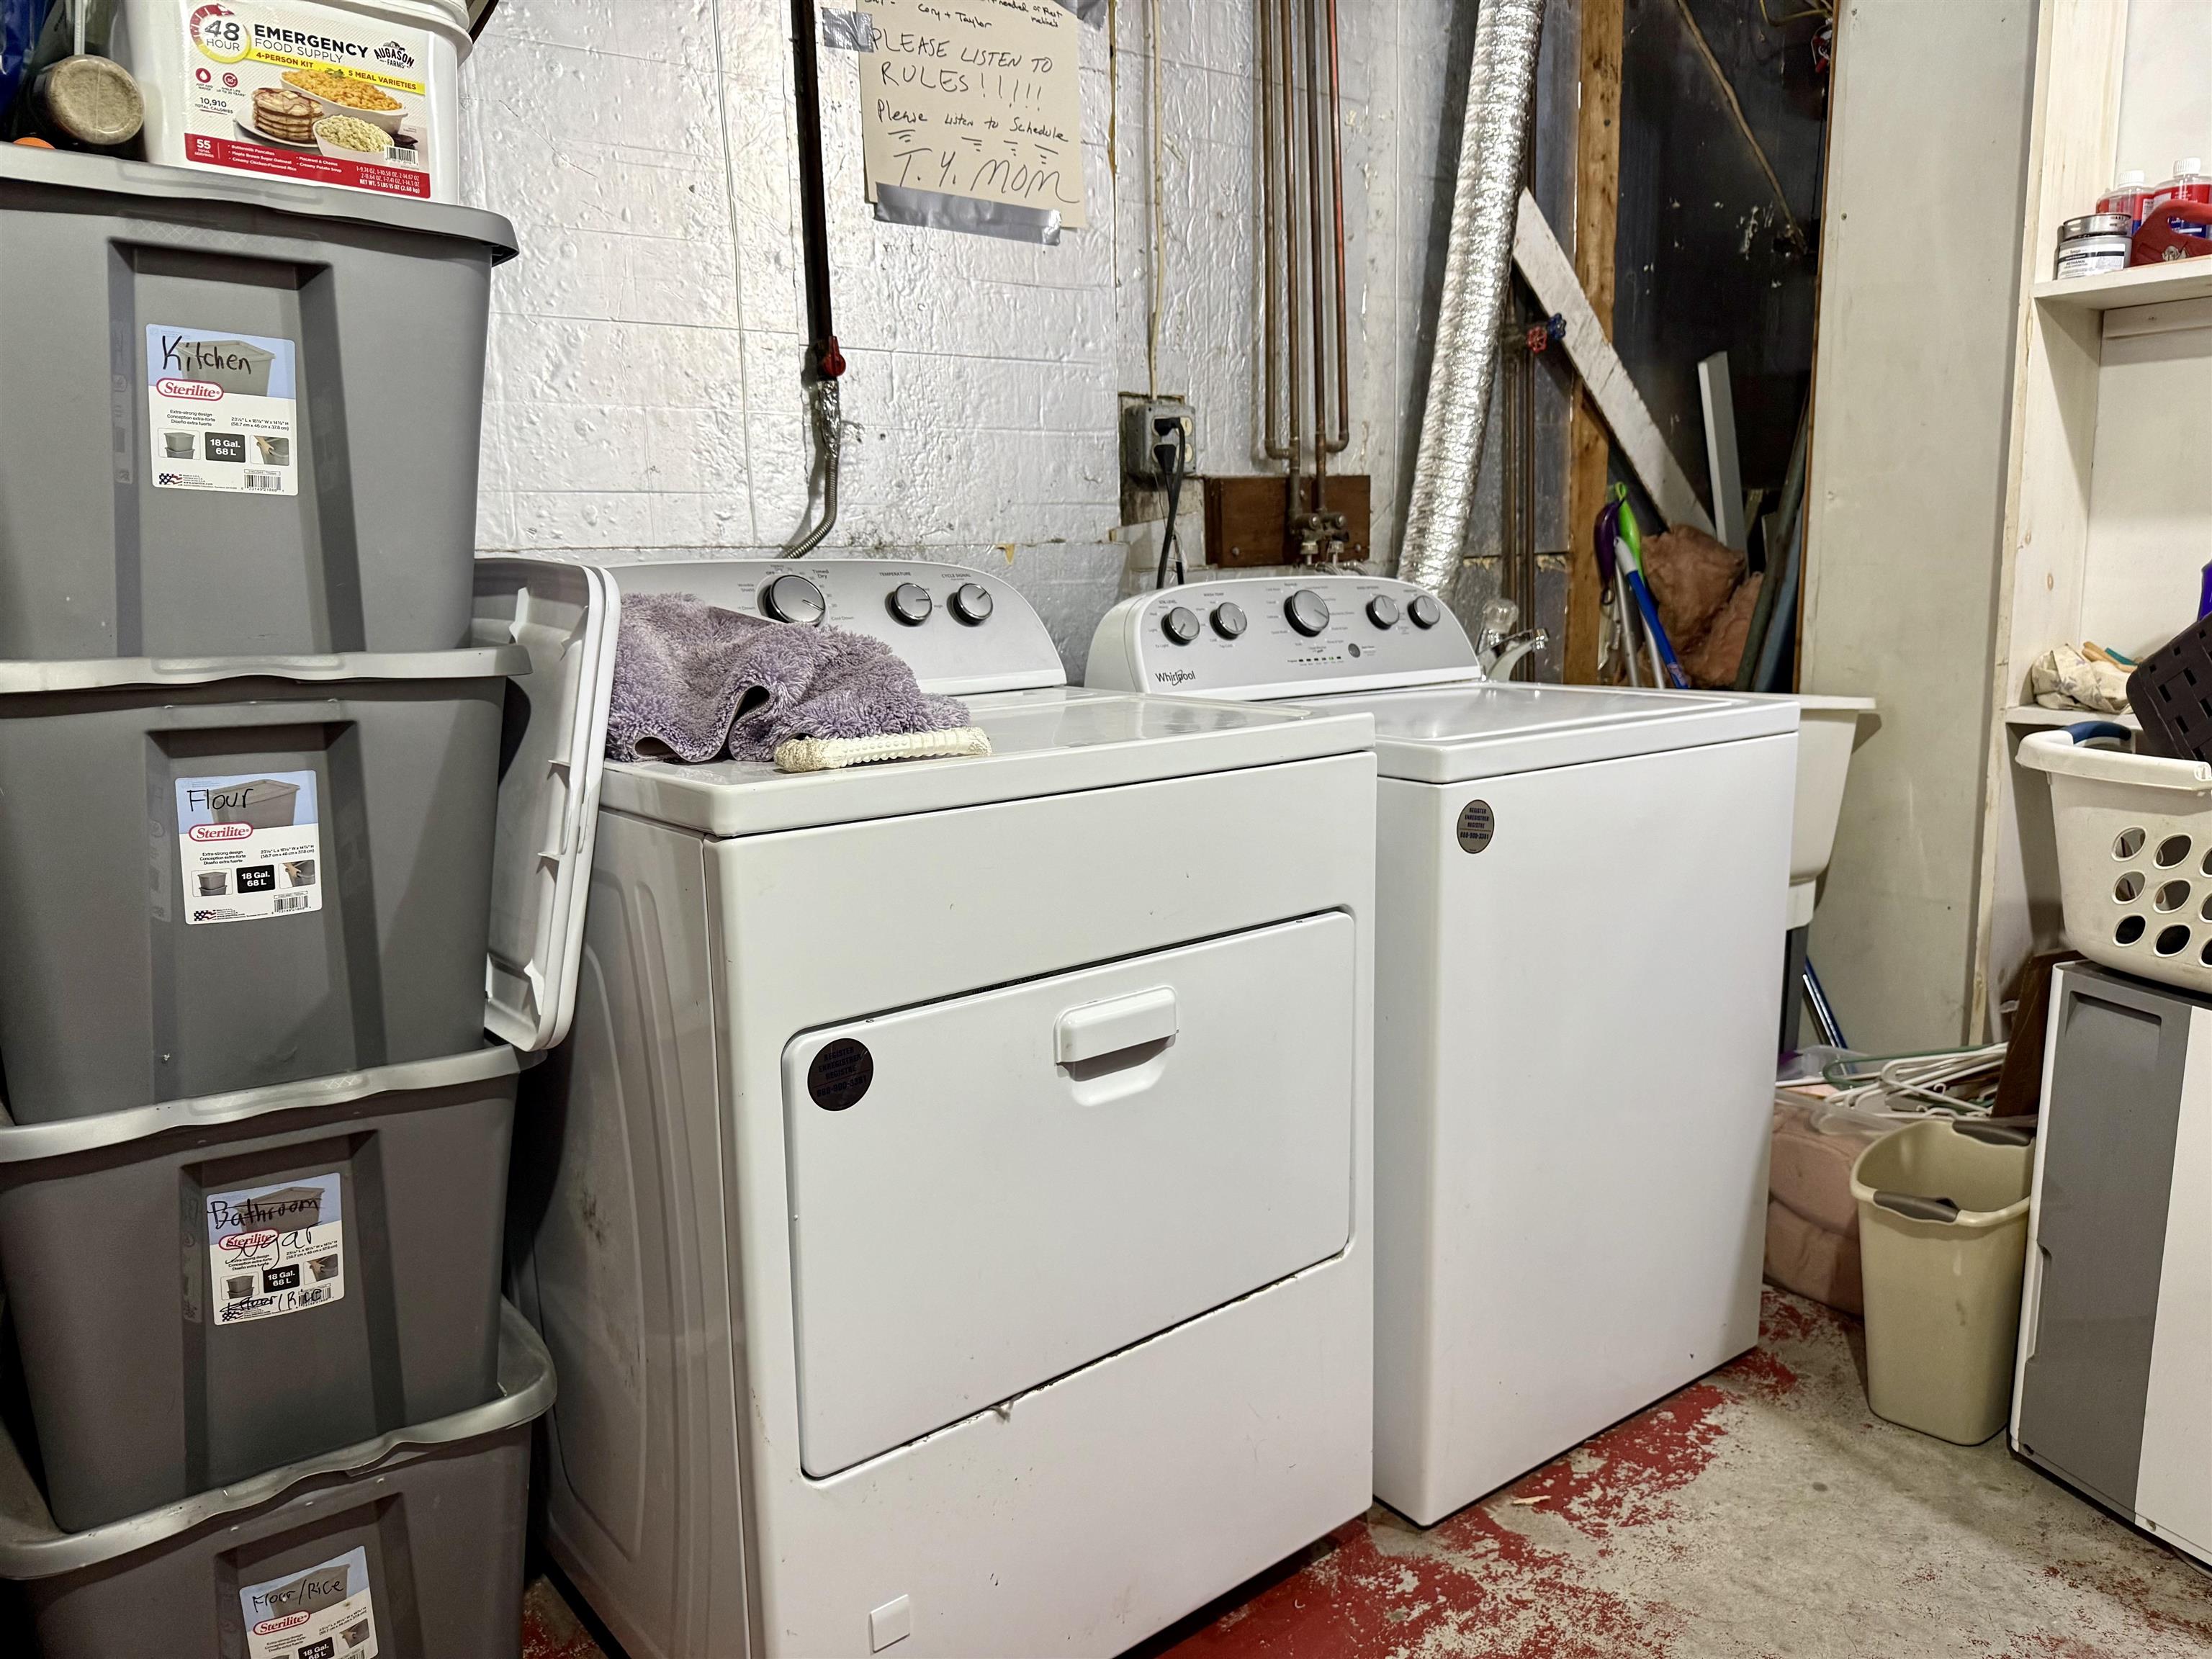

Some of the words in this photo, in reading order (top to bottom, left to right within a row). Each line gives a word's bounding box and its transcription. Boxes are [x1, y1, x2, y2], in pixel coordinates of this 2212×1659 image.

[956, 12, 992, 28] Taylor
[204, 20, 240, 41] 48
[206, 39, 240, 51] HOUR
[254, 24, 368, 58] EMERGENCY
[255, 37, 292, 53] FOOD
[297, 45, 343, 63] SUPPLY
[374, 48, 415, 68] AUGASON
[871, 28, 950, 58] PLEASE
[961, 48, 1022, 67] LISTEN
[1032, 57, 1053, 73] TO
[256, 52, 298, 66] 4-PERSON
[300, 60, 314, 68] KIT
[387, 59, 405, 69] FARMS
[356, 72, 377, 81] MEAL
[378, 76, 416, 90] VARIETIES
[200, 97, 227, 108] 10,910
[210, 105, 233, 114] CALORIES
[877, 99, 927, 123] Please
[984, 117, 999, 130] to
[1010, 117, 1069, 143] Schedule
[197, 139, 211, 149] 55
[162, 335, 251, 375] Kitchen
[163, 382, 217, 398] Sterilite
[223, 439, 240, 448] Gal.
[1155, 670, 1196, 685] Whirlpool
[186, 788, 253, 811] Flour
[196, 827, 246, 839] Sterilite
[210, 1198, 322, 1229] Bathroom
[260, 1616, 305, 1633] Sterilite
[314, 1645, 329, 1654] Gal.
